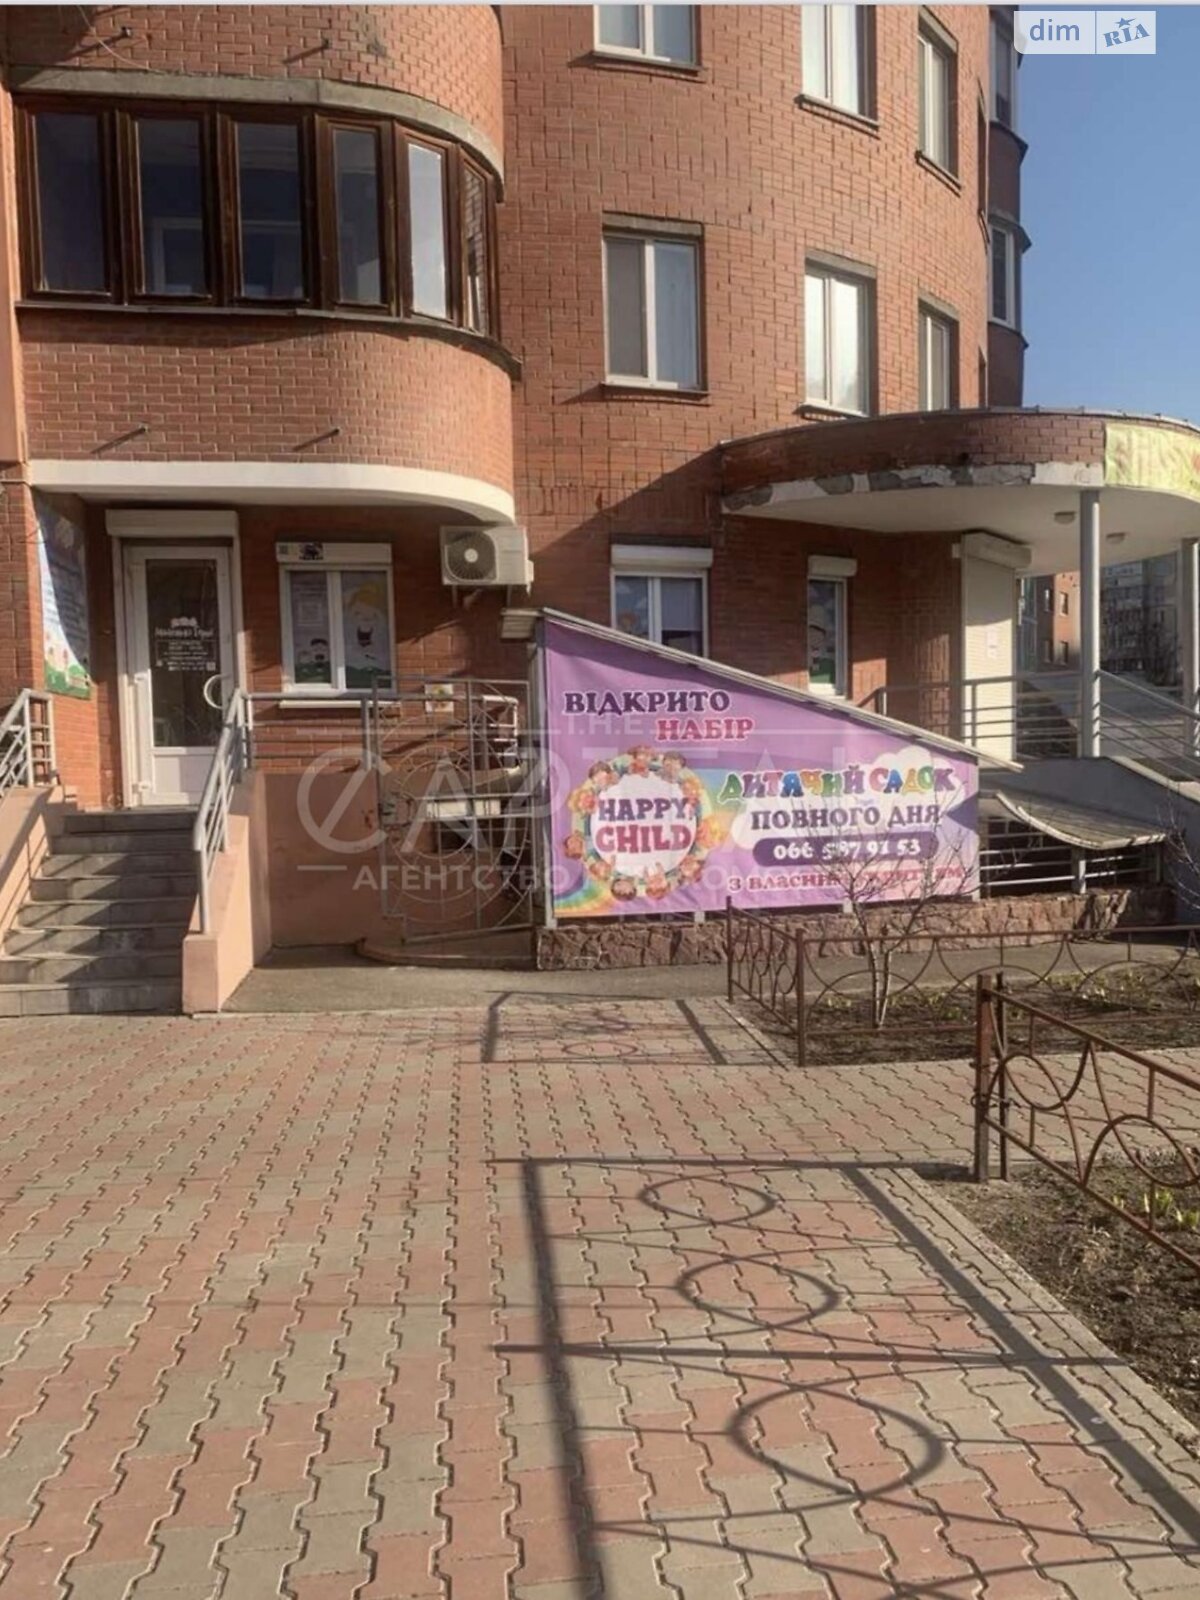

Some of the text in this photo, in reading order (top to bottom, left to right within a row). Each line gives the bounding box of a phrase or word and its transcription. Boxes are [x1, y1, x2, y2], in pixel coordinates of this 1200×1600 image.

[564, 690, 731, 716] ВІДКРИТО
[657, 717, 753, 741] НАБІР
[719, 765, 956, 803] ДИТЯЧИЙ САДОК
[598, 797, 690, 822] HAPPY
[751, 804, 942, 831] ПОВНОГО ДНЯ
[595, 824, 693, 854] CHILD
